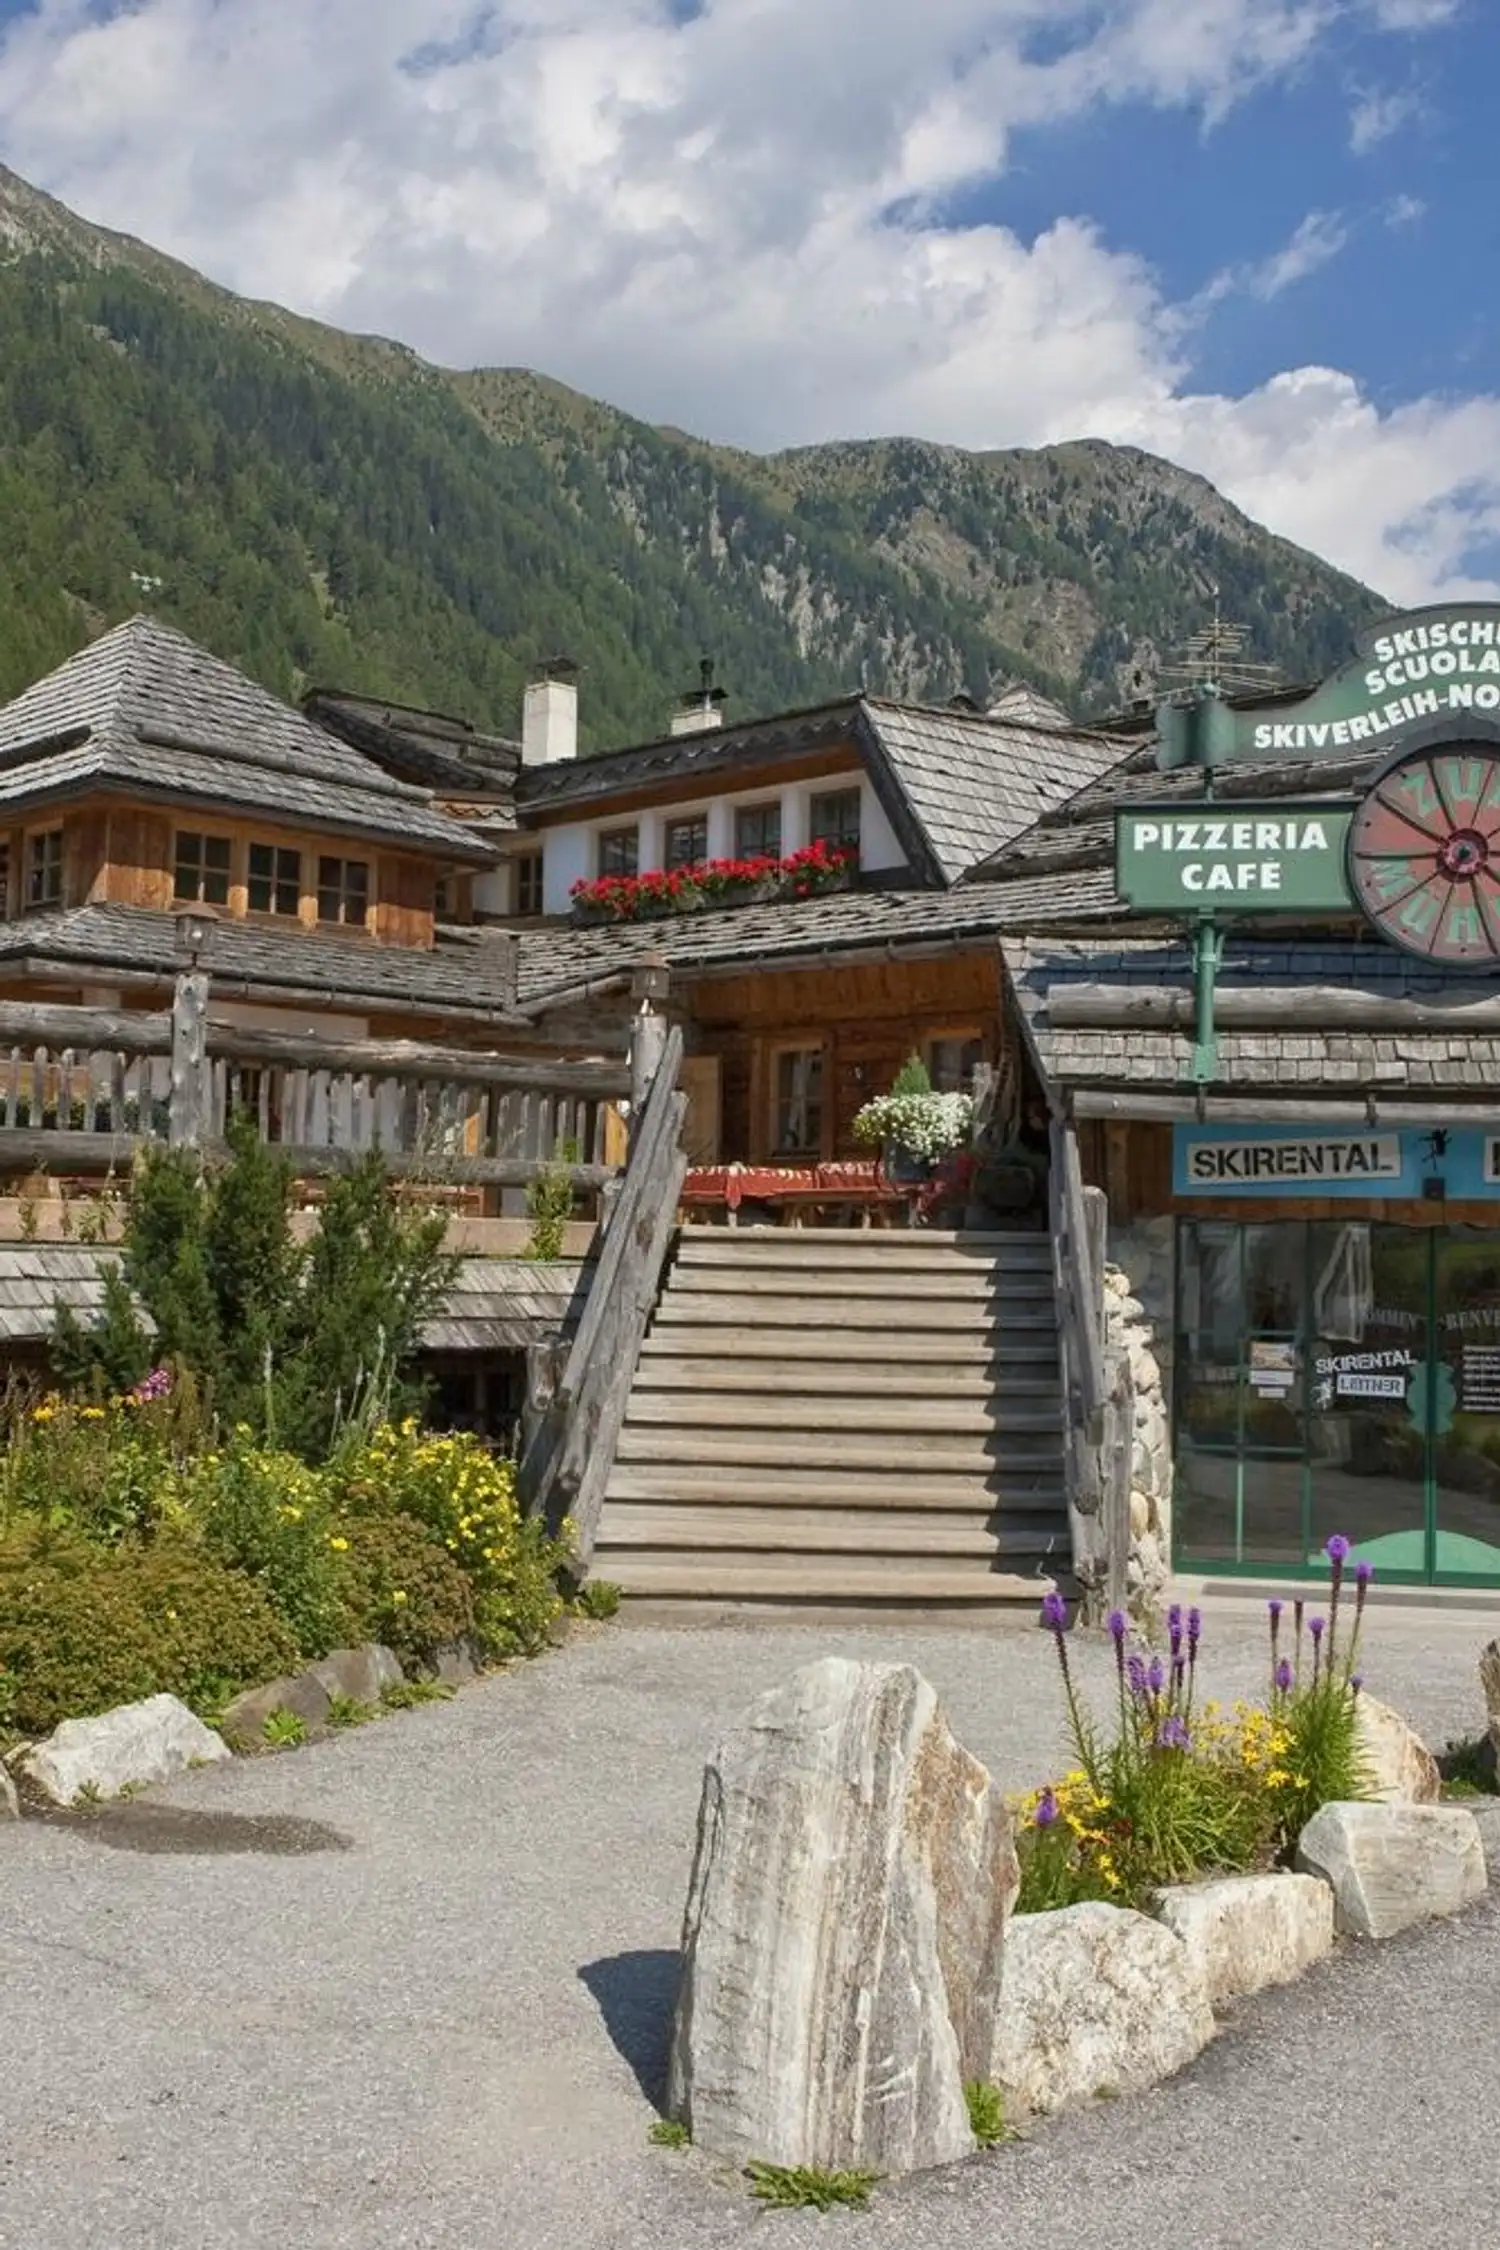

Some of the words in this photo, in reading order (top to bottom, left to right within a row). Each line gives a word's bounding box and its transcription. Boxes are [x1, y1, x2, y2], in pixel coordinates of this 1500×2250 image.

[1374, 621, 1500, 662] SKISCH
[1365, 650, 1500, 695] SCUOLA
[1254, 683, 1500, 748] SKIVERLEIH-NO
[1133, 822, 1329, 851] PIZZERIA
[1193, 1142, 1393, 1177] SKIRENTAL
[1315, 1350, 1418, 1374] SKIRENTAL
